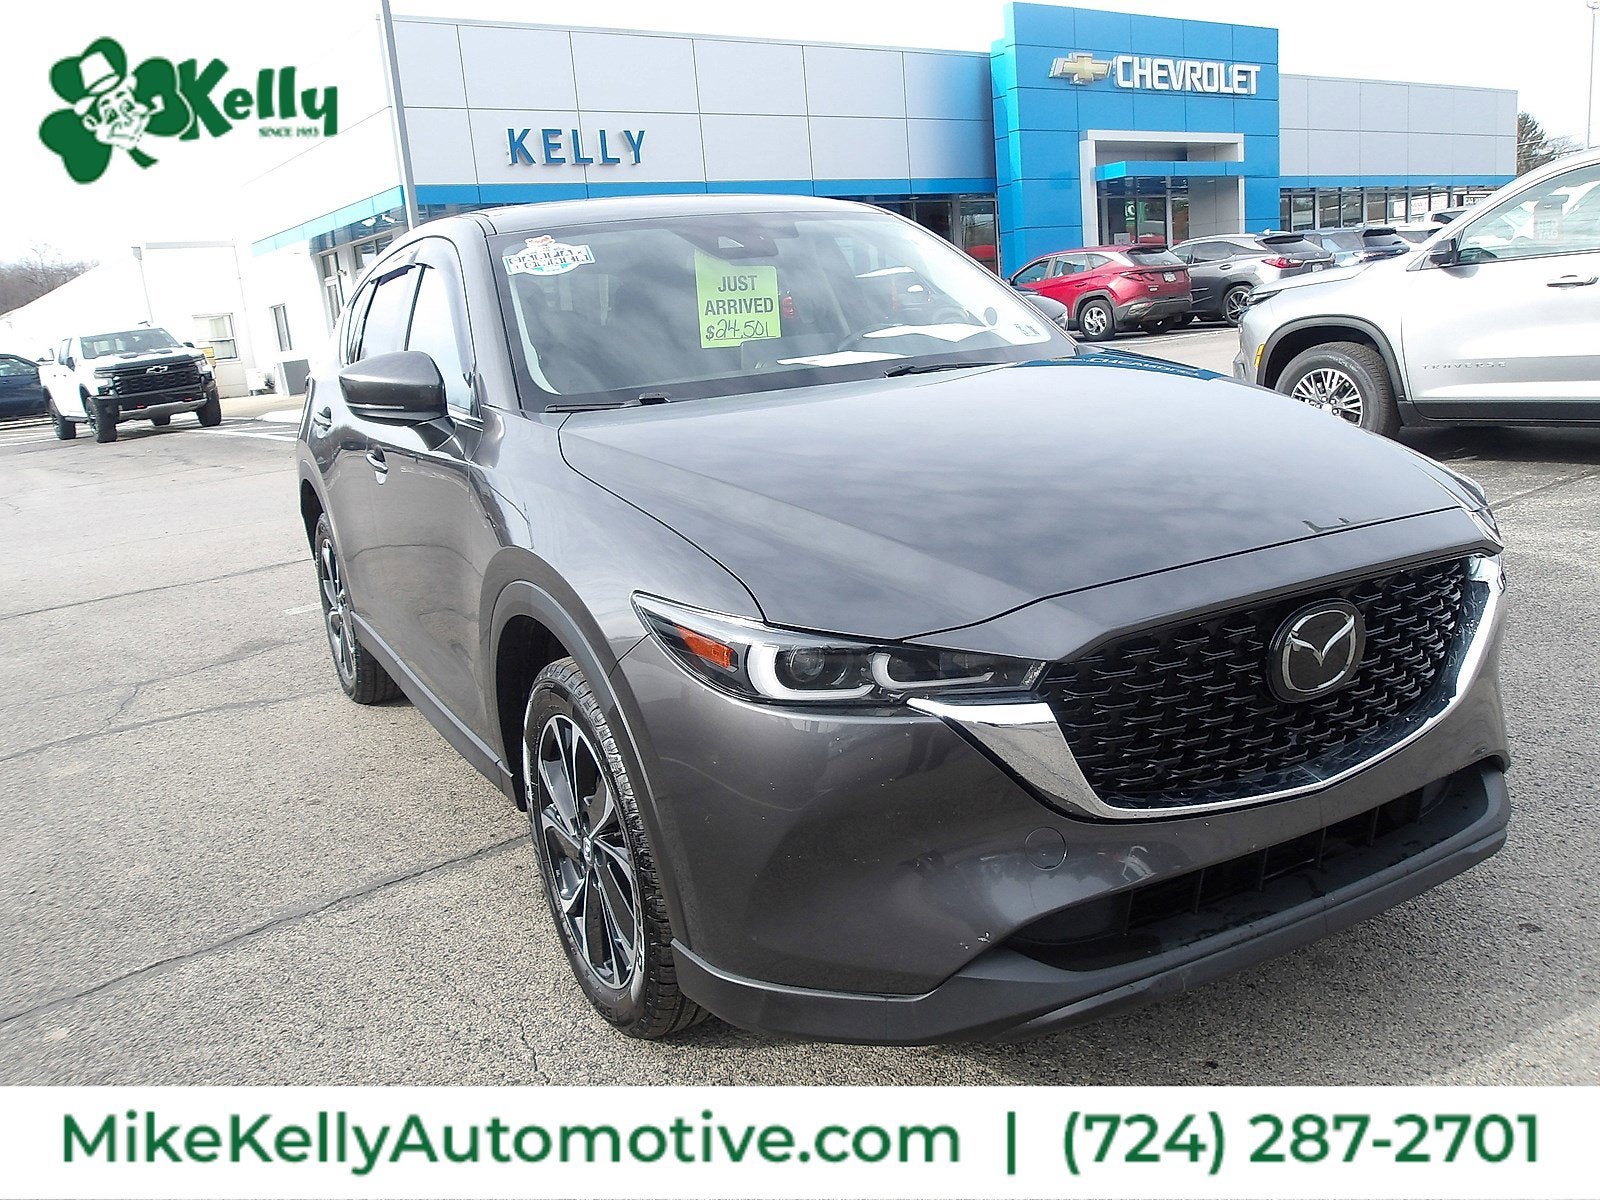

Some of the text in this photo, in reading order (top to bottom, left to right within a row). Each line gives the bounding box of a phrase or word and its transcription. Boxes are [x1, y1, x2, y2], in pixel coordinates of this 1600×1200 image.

[1115, 55, 1261, 95] CHEVROLET
[506, 128, 646, 166] KELLY
[718, 275, 758, 292] JUST
[704, 297, 774, 316] ARRIVED
